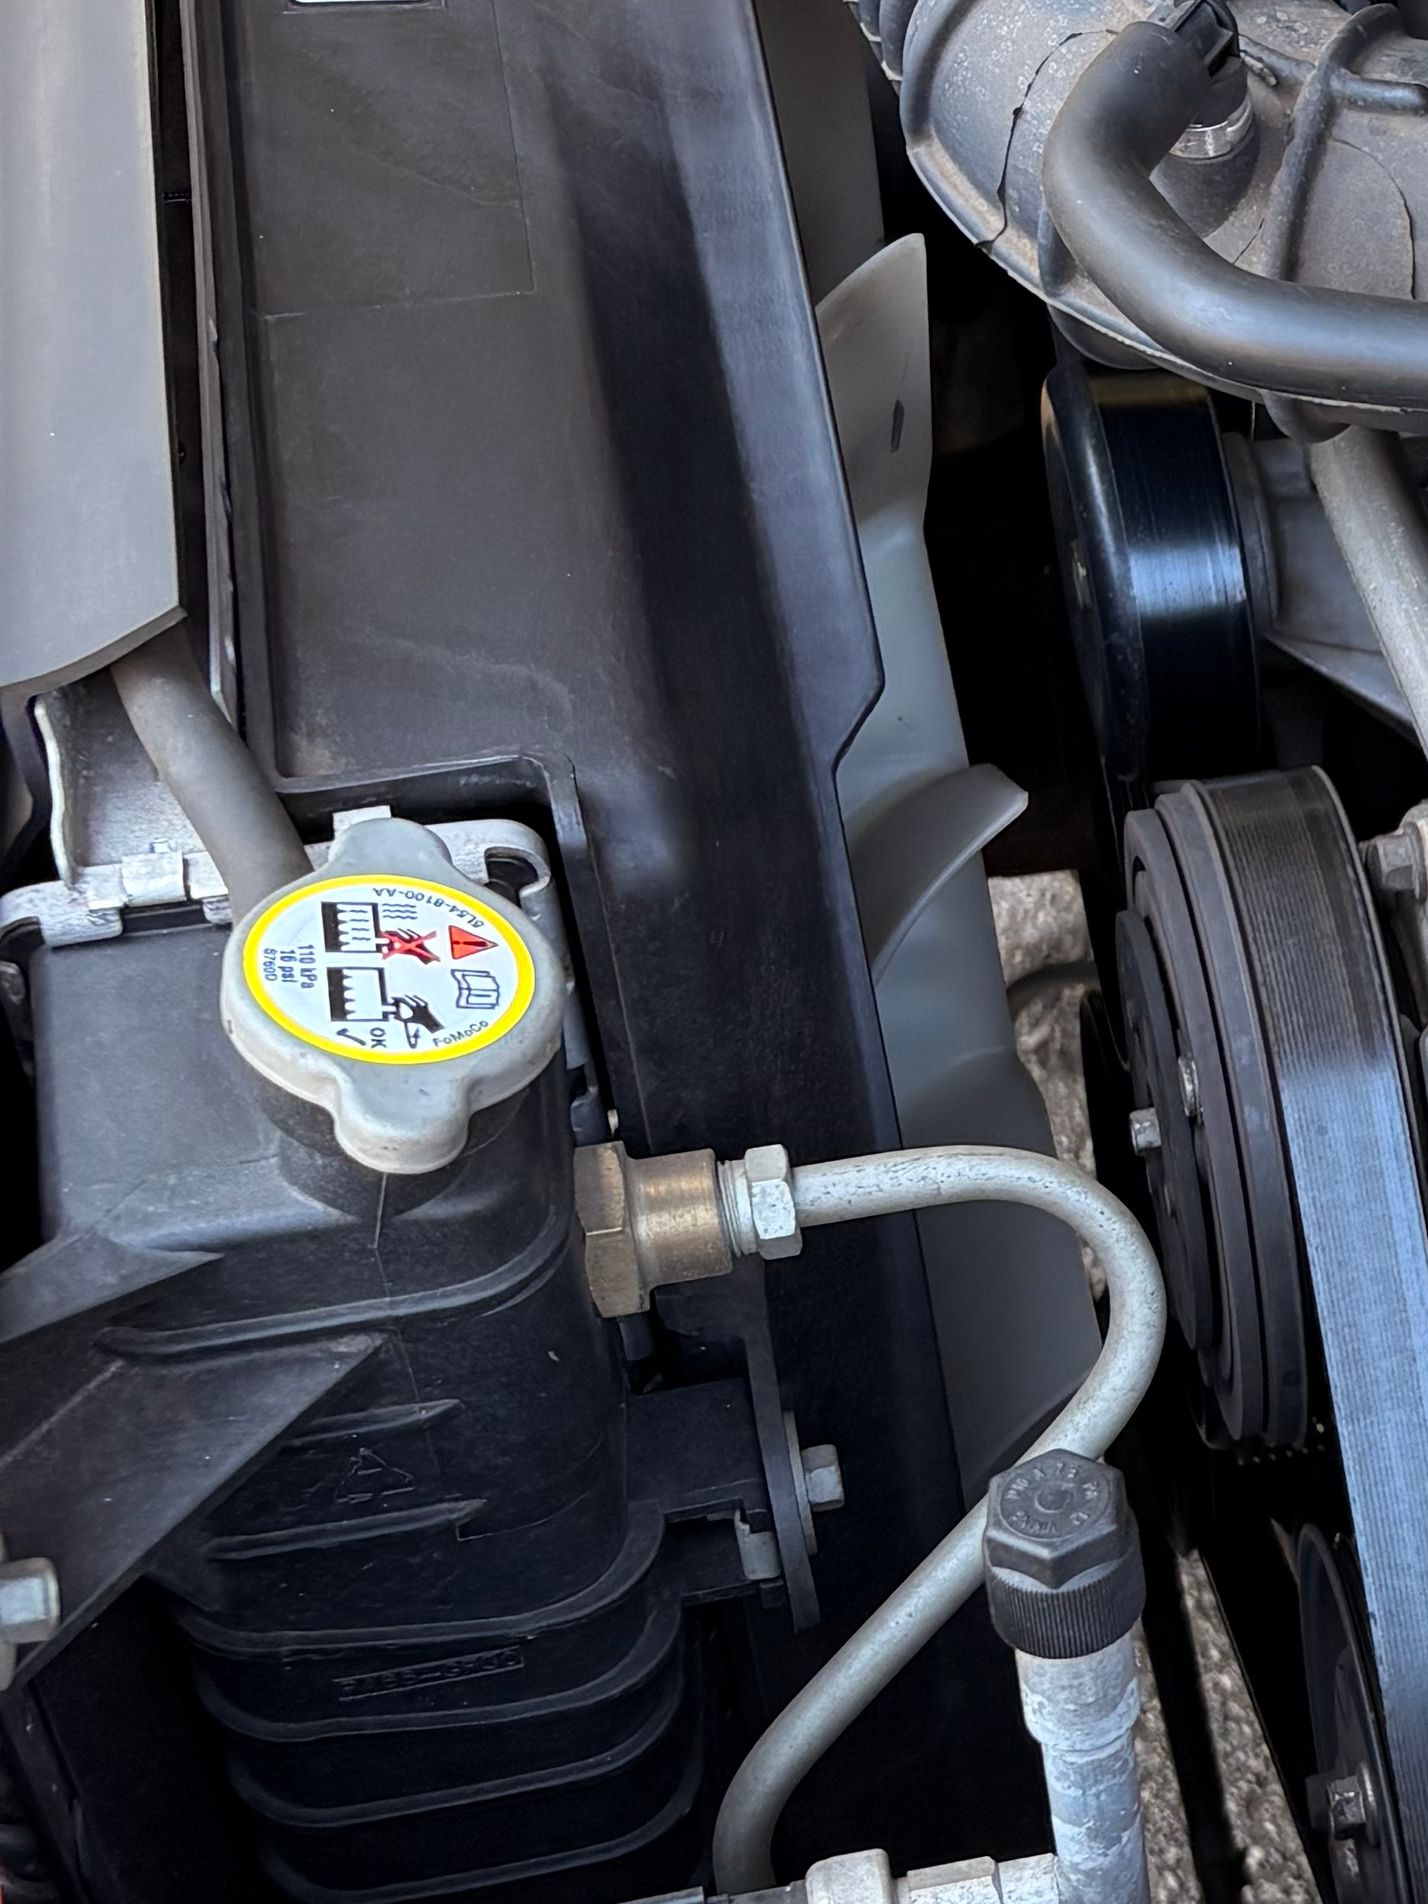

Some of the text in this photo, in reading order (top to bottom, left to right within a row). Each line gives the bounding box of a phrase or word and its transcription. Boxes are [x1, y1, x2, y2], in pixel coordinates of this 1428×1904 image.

[278, 949, 299, 983] 16 psi
[297, 944, 318, 989] 110 kPa
[370, 1027, 387, 1048] OK
[432, 1019, 489, 1048] FoMoCo
